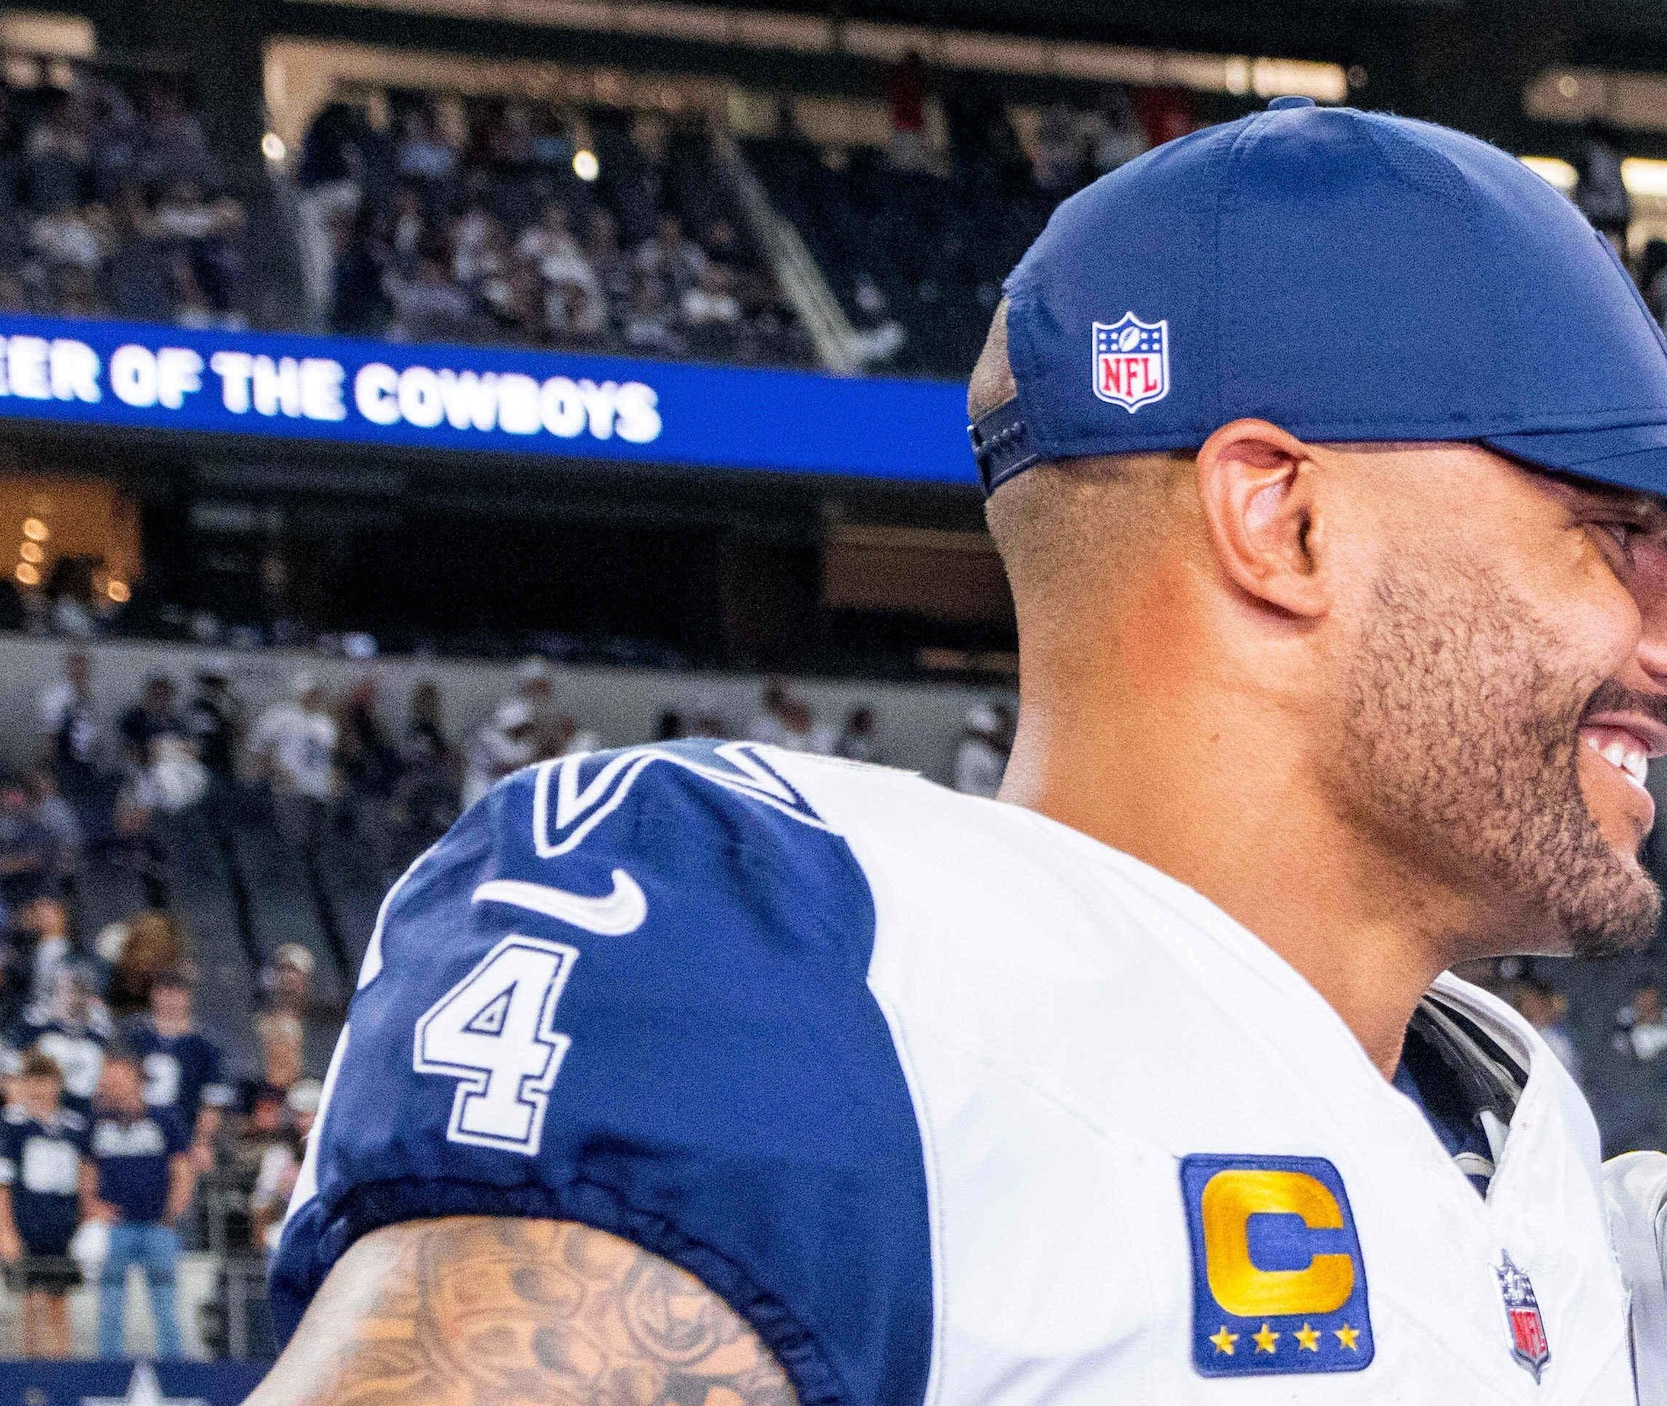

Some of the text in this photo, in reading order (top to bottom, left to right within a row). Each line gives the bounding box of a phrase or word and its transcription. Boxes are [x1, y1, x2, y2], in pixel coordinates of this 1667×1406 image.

[0, 335, 662, 443] ER OF THE COWBOYS
[1101, 357, 1158, 397] NFL
[412, 932, 581, 1158] 4
[1201, 1168, 1356, 1318] C
